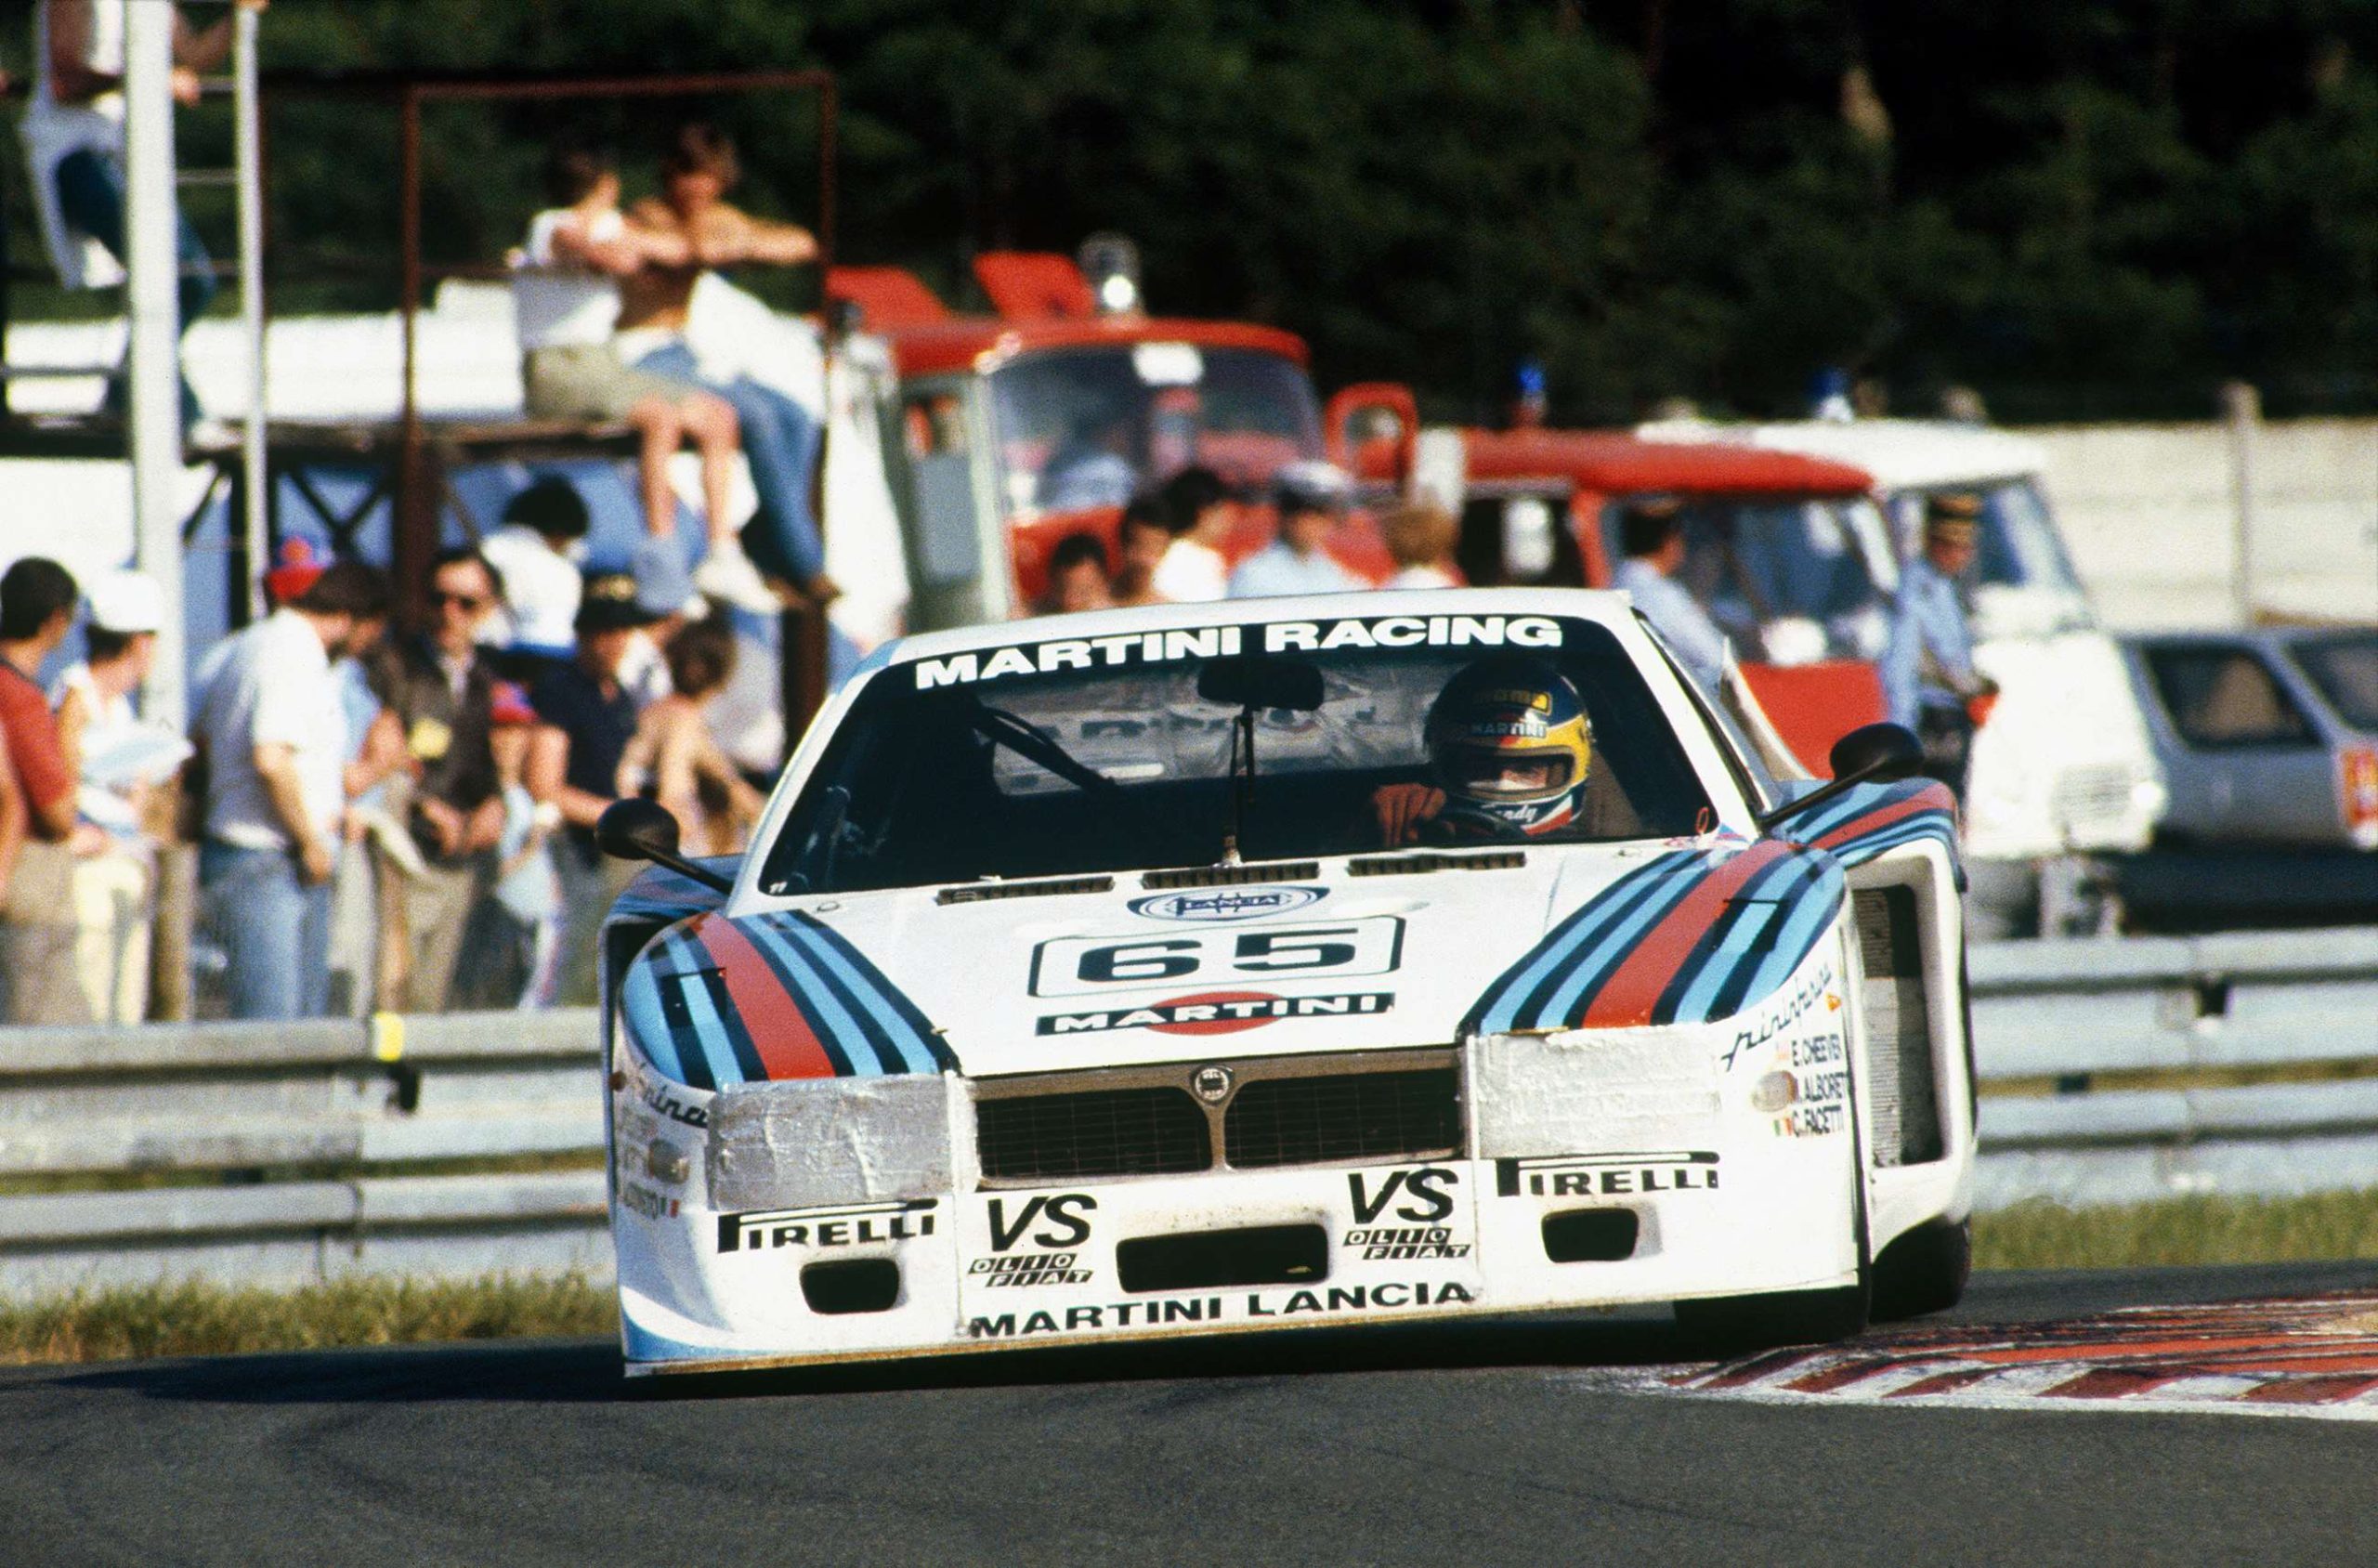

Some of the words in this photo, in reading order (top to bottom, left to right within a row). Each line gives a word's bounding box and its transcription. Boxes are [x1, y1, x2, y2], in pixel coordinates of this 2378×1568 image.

[915, 626, 1240, 690] MARTINI
[1264, 616, 1562, 653] RACING
[1077, 928, 1359, 983] 65
[1053, 994, 1378, 1033] MARTINI
[1347, 1167, 1459, 1224] VS
[1496, 1152, 1720, 1196] PIRELLI
[717, 1199, 938, 1253] PIRELLI
[987, 1194, 1098, 1252] VS
[1344, 1229, 1450, 1246] OLIO
[971, 1254, 1075, 1274] OLIO
[1365, 1245, 1470, 1260] FIAT
[988, 1270, 1092, 1287] FIAT
[971, 1297, 1222, 1338] MARTINI
[1248, 1281, 1473, 1319] LANCIA
